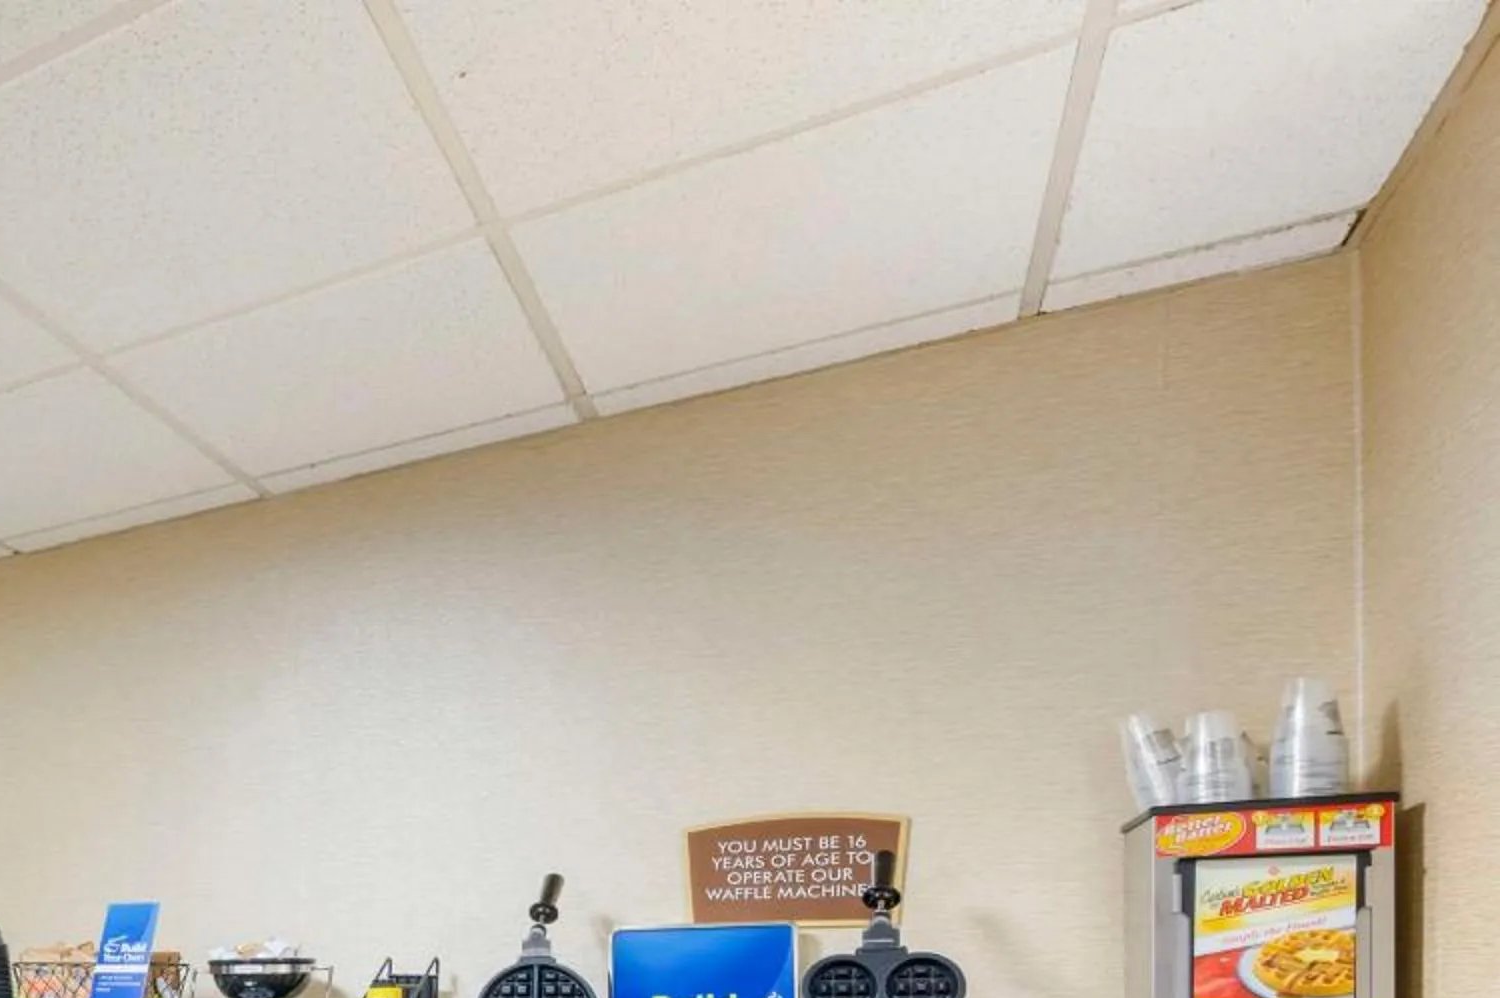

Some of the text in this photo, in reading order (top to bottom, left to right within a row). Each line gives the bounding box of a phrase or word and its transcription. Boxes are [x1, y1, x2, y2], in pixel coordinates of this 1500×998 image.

[717, 835, 867, 853] YOU MUST BE 16
[711, 851, 872, 871] YEARS OF AGE TO
[727, 868, 853, 885] OPERATE OUR
[705, 886, 772, 900] WAFFLE
[1219, 885, 1310, 917] MALTED
